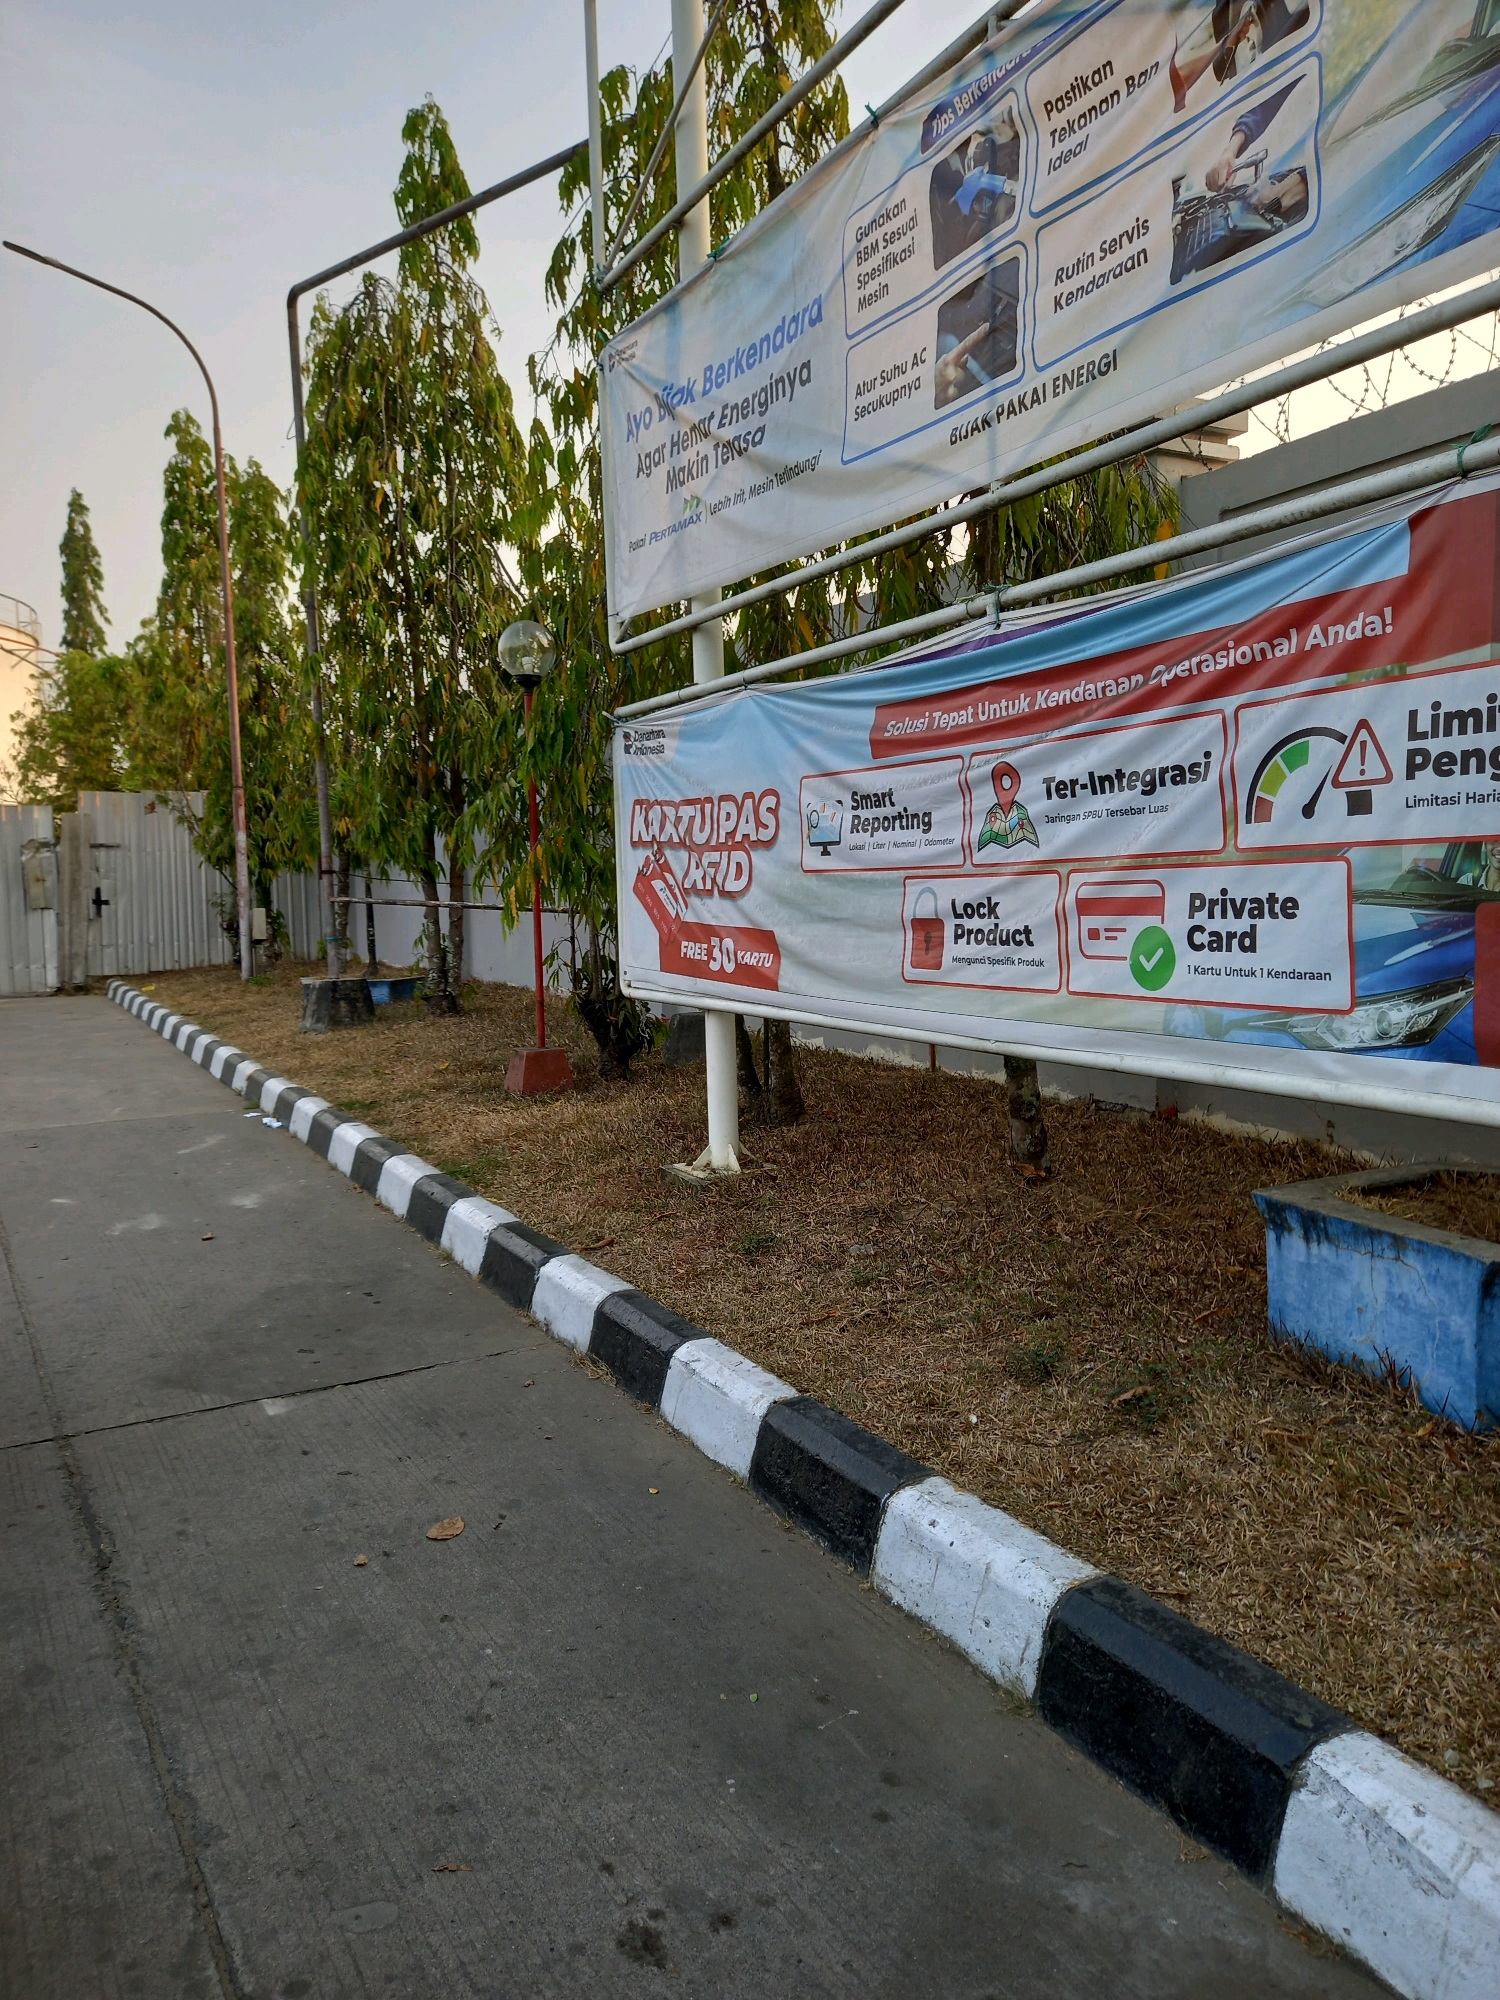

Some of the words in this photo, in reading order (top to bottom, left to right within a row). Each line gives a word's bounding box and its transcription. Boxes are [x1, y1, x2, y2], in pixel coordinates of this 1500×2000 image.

[1043, 60, 1114, 122] Pastikan
[1049, 89, 1121, 149] Tekanan
[1124, 61, 1159, 98] Ban
[931, 106, 956, 138] Tips
[1047, 133, 1090, 176] Ideal
[855, 198, 907, 243] Gunakan
[856, 242, 880, 268] BBM
[882, 208, 918, 249] Sesuai
[857, 236, 915, 290] Spesifikasi
[1054, 251, 1094, 287] Rutin
[1099, 216, 1150, 262] Servis
[857, 282, 889, 313] Mesin
[1053, 248, 1149, 314] Kendaraan
[626, 406, 653, 443] Ayo
[654, 377, 697, 422] Bijak
[702, 294, 823, 397] Berkendara
[855, 377, 878, 400] Atur
[879, 359, 908, 384] Suhu
[911, 346, 927, 371] AC
[636, 442, 667, 478] Agar
[670, 411, 715, 458] Hemat
[717, 359, 812, 430] Energinya
[854, 375, 921, 422] Secukupnya
[949, 409, 993, 446] BIJAK
[995, 382, 1047, 424] PAKAI
[1052, 349, 1118, 399] ENERGI
[666, 451, 709, 494] Makin
[713, 424, 766, 470] Terasa
[629, 534, 647, 553] Pakai
[649, 511, 703, 545] PERTAMAX
[709, 496, 732, 516] Lebih
[732, 489, 747, 505] Irit,
[748, 476, 774, 500] Mesin
[774, 450, 823, 487] Terlindungi
[883, 711, 930, 738] Solusi
[932, 706, 974, 731] Tepat
[977, 693, 1032, 721] Untuk
[1034, 673, 1145, 711] Kendaraan
[1148, 628, 1298, 687] Operasional
[1304, 606, 1394, 651] Anda!
[1408, 692, 1500, 742] Limi
[851, 788, 896, 811] Smart
[1042, 751, 1212, 801] Ter-Integrasi
[718, 793, 779, 843] PAS
[850, 806, 933, 838] Reporting
[1045, 812, 1081, 824] Jaringan
[1082, 810, 1103, 821] SPBU
[1105, 805, 1146, 818] Tersebar
[1148, 804, 1169, 814] Luas
[1405, 792, 1461, 808] Limitasi
[849, 842, 867, 852] Lokasi
[872, 841, 887, 850] Liter
[892, 839, 917, 849] Nominal
[924, 837, 956, 847] Odometer
[951, 896, 1000, 920] Lock
[1187, 887, 1300, 920] Private
[680, 940, 708, 961] FREE
[708, 936, 736, 974] 30
[737, 950, 774, 967] KARTU
[953, 923, 1035, 947] Product
[1186, 923, 1258, 953] Card
[951, 955, 987, 967] Mengunci
[987, 956, 1016, 968] Spesifik
[1017, 957, 1045, 968] Produk
[1187, 964, 1192, 975] 1
[1193, 964, 1222, 976] Kartu
[1224, 966, 1258, 978] Untuk
[1259, 967, 1264, 979] 1
[1266, 968, 1332, 981] Kendaraan
